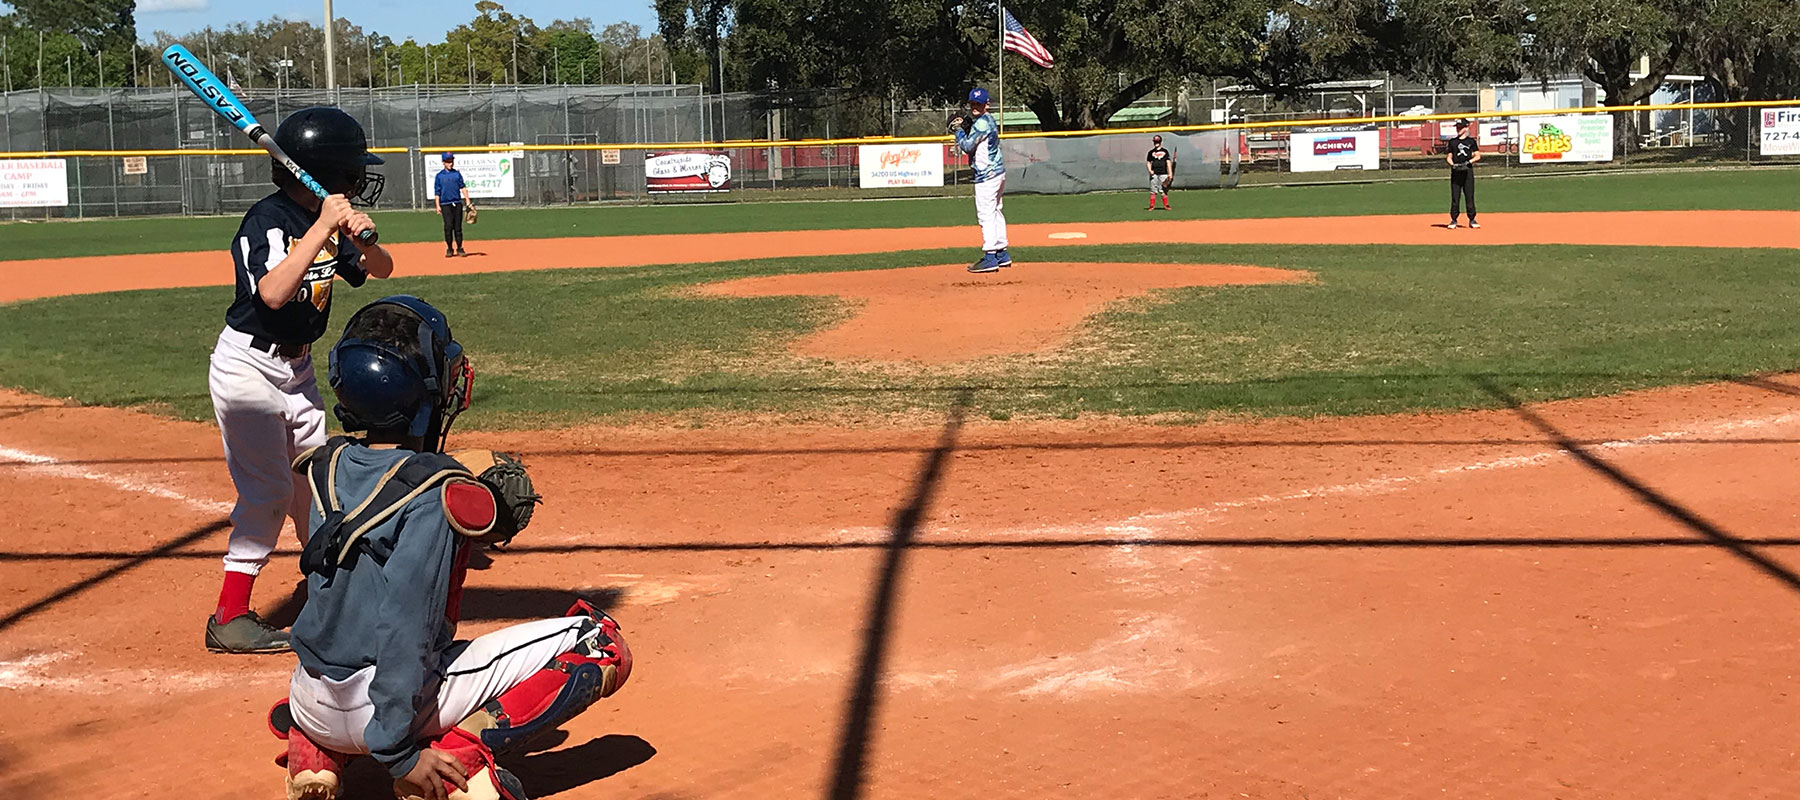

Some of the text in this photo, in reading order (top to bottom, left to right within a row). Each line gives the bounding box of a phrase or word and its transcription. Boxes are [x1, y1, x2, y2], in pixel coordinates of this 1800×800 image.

[167, 51, 245, 123] EASTON
[1315, 142, 1354, 150] ACHIEVA
[4, 172, 33, 180] CAMP
